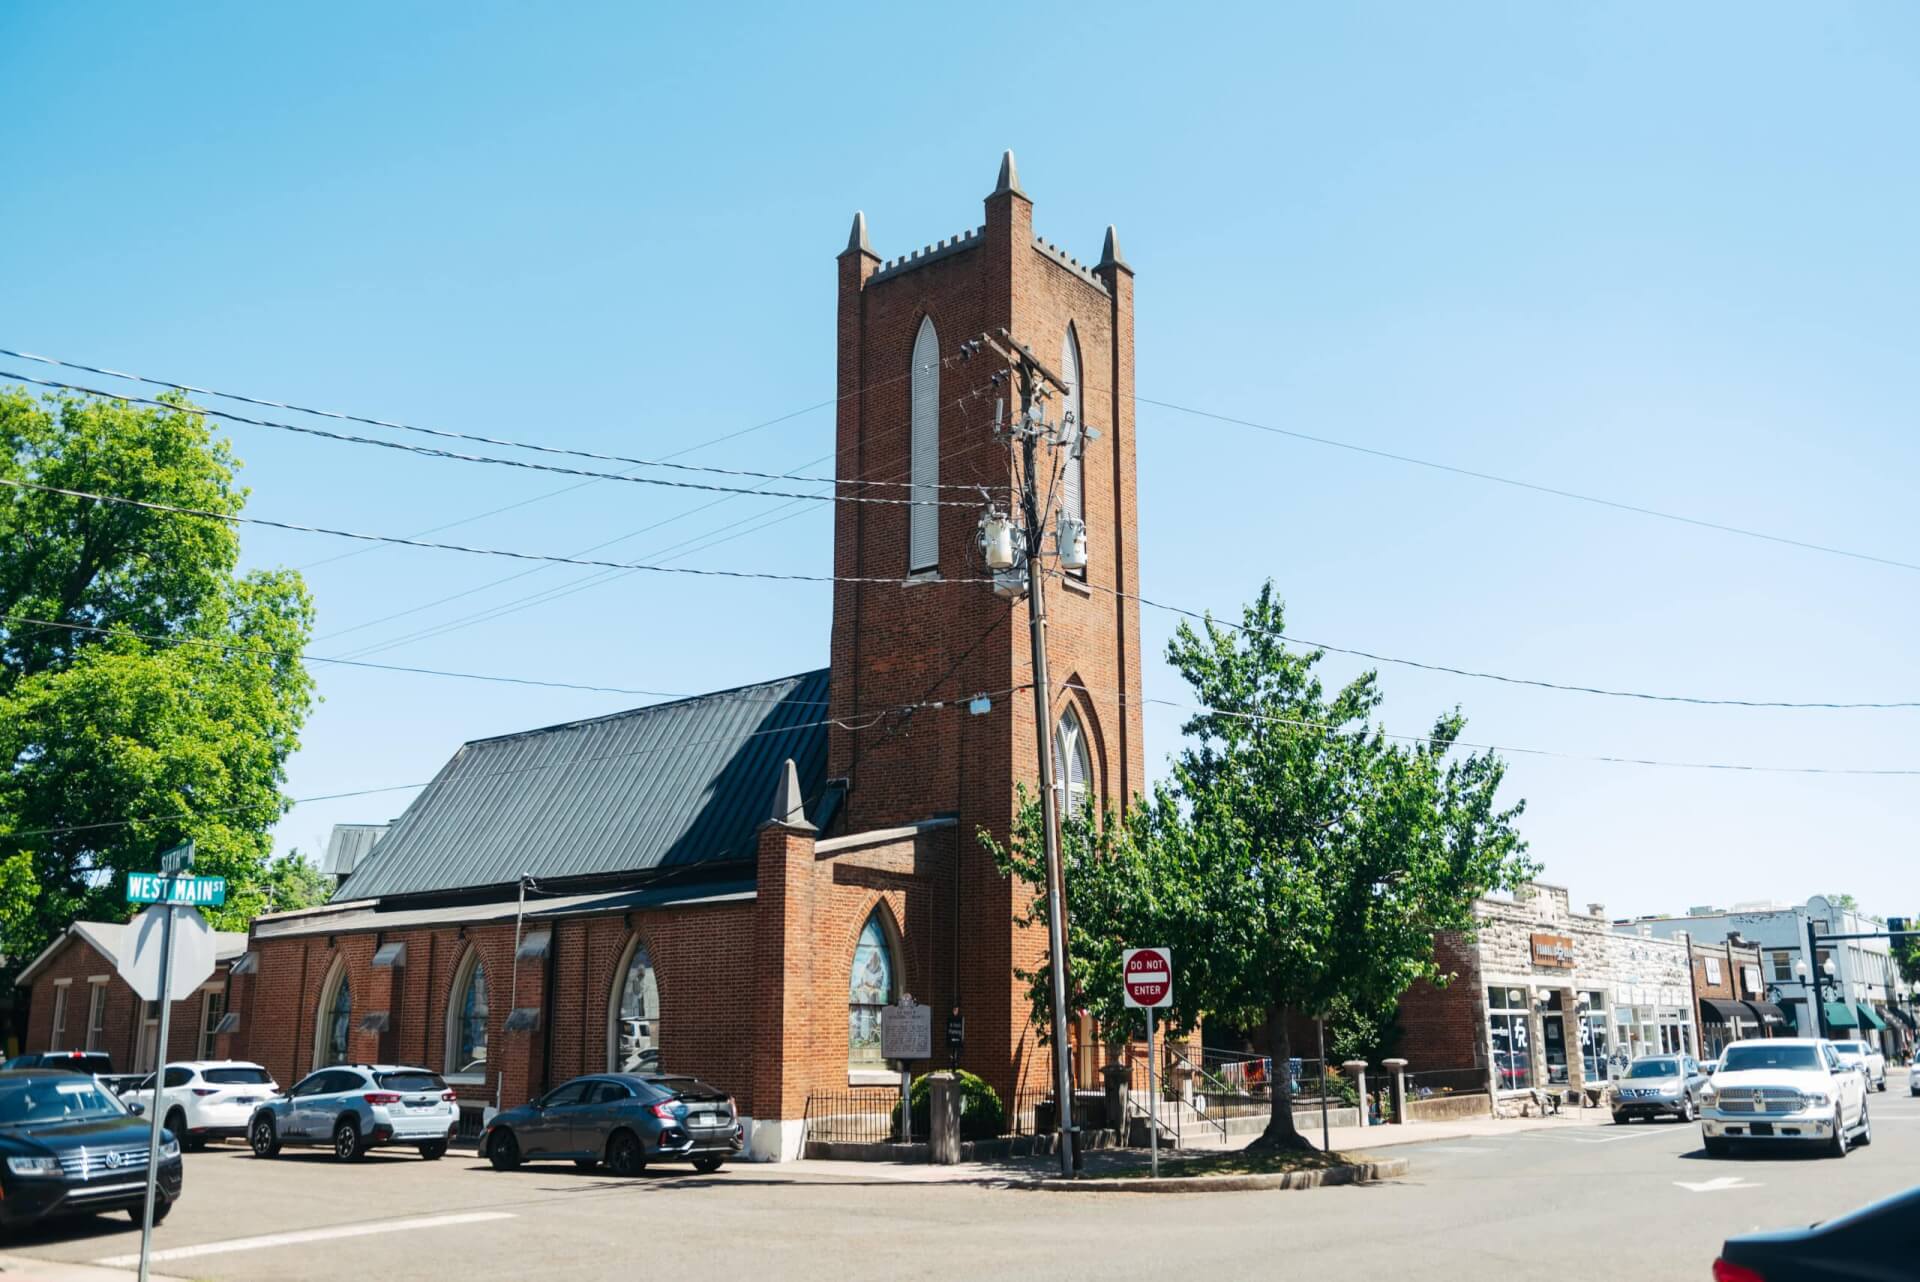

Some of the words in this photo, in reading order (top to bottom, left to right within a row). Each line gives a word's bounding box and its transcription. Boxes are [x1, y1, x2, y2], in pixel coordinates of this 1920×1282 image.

[128, 876, 169, 899] WEST
[175, 879, 213, 901] MAIN
[213, 880, 224, 892] ST
[1130, 961, 1142, 970] DO
[1146, 960, 1164, 969] NOT
[1134, 985, 1161, 995] ENTER
